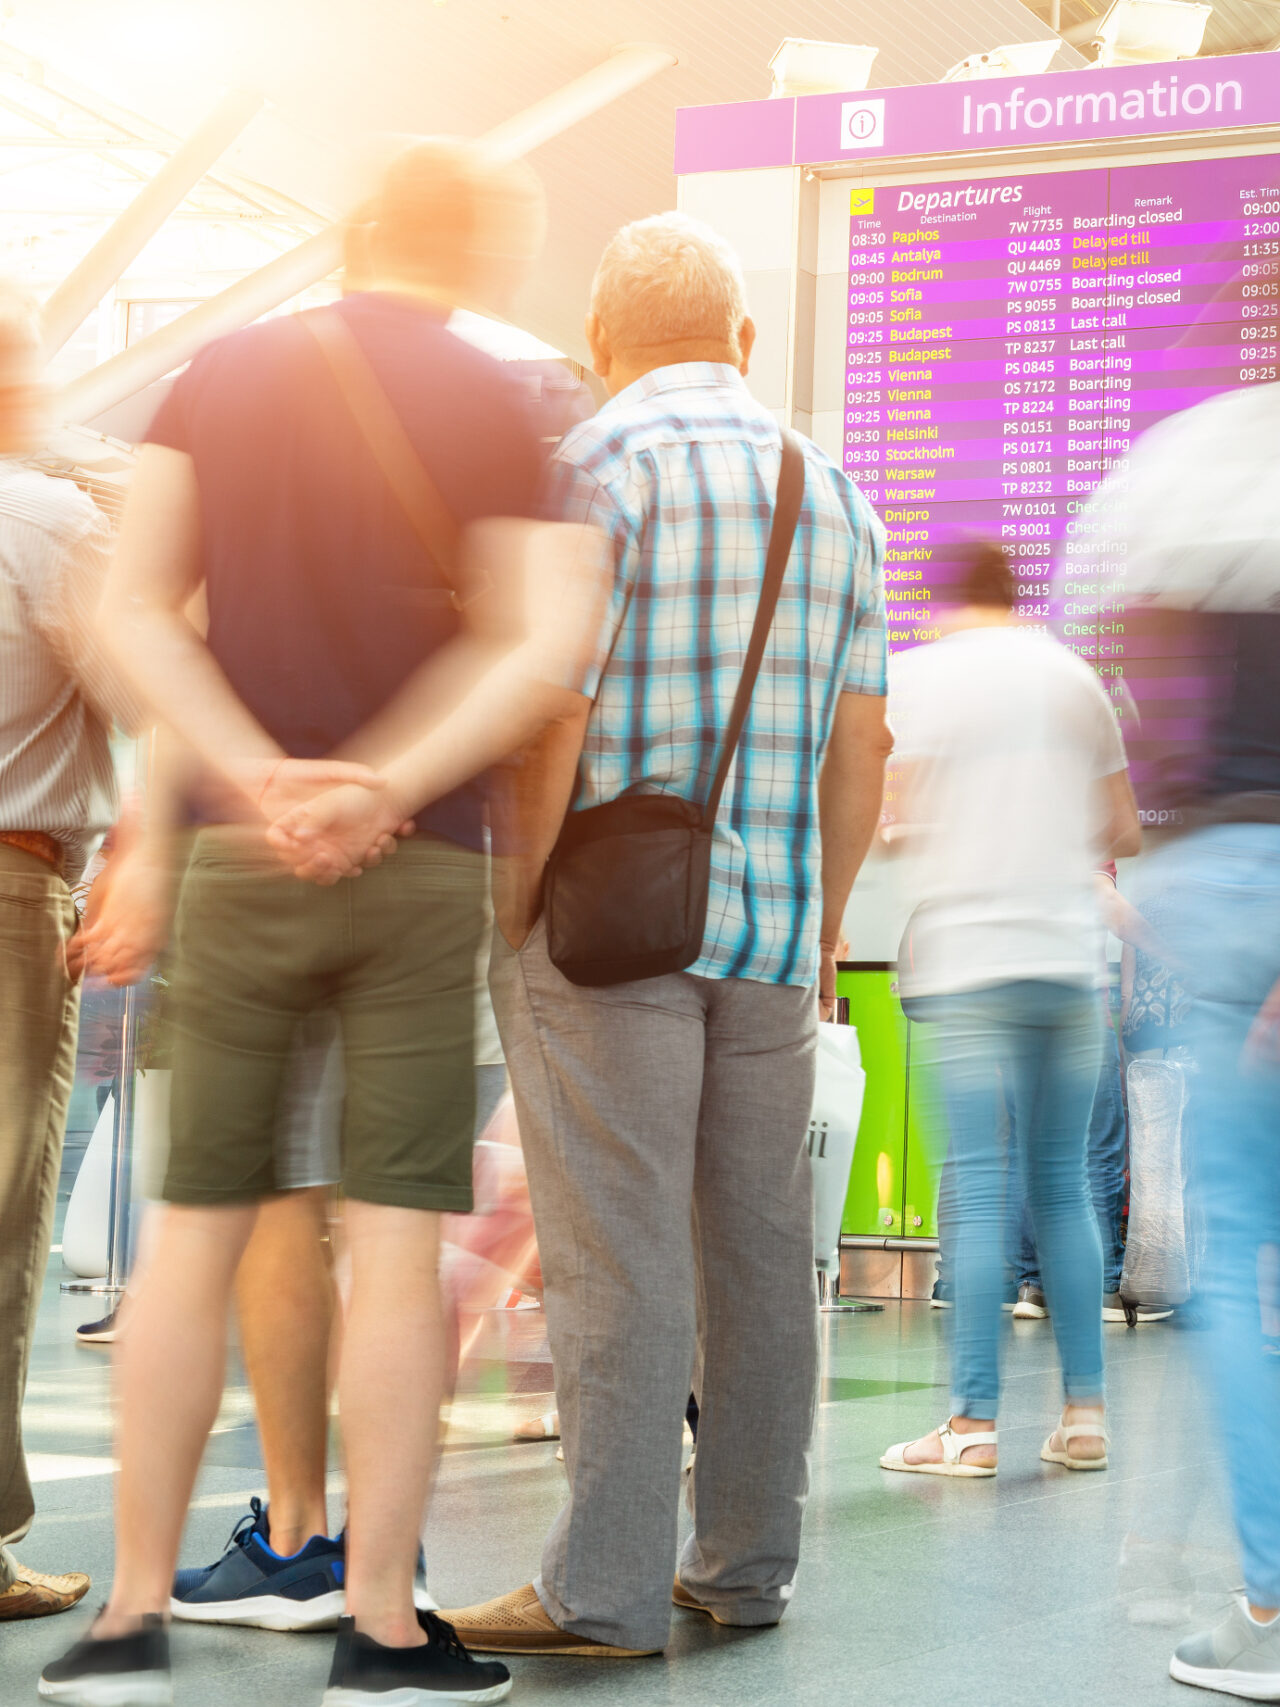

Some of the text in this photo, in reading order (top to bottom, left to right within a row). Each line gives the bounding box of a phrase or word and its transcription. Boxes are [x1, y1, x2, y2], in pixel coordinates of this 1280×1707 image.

[960, 78, 1245, 136] Information
[897, 184, 1023, 214] Departures
[1134, 195, 1173, 208] Remark
[1239, 189, 1257, 199] Est.
[1023, 205, 1052, 218] Flight
[1243, 200, 1280, 216] 09:00
[858, 219, 881, 230] Time
[920, 211, 977, 225] Destination
[1073, 207, 1183, 230] Boarding closed
[1008, 218, 1063, 235] 7W 7735
[1243, 221, 1280, 237] 12:00
[851, 232, 886, 247] 08:30
[892, 228, 940, 246] Paphos
[1072, 231, 1151, 251] Delayed till
[1007, 238, 1062, 256] QU 4403
[1243, 241, 1280, 257] 11:35
[851, 251, 886, 267] 08:45
[890, 247, 942, 264] Antalya
[1072, 251, 1150, 271] Delayed till
[1007, 258, 1062, 276] QU 4469
[850, 271, 885, 286] 09:00
[891, 268, 944, 283] Bodrum
[1071, 268, 1182, 290] Boarding closed
[1007, 277, 1062, 294] 7W 0755
[850, 291, 885, 306] 09:05
[890, 287, 923, 303] Sofia
[1071, 288, 1181, 310] Boarding closed
[1007, 298, 1057, 314] PS 9055
[849, 310, 884, 325] 09:05
[889, 307, 922, 322] Sofia
[1070, 312, 1127, 330] Last call
[889, 325, 953, 343] Budapest
[1006, 318, 1056, 334] PS 0813
[849, 330, 884, 345] 09:25
[1069, 334, 1126, 351] Last call
[1004, 339, 1056, 355] TP 8237
[848, 351, 882, 365] 09:25
[888, 347, 952, 364] Budapest
[1069, 355, 1132, 372] Boarding
[1004, 359, 1055, 375] PS 0845
[847, 370, 882, 385] 09:25
[887, 368, 933, 383] Vienna
[1069, 375, 1132, 392] Boarding
[887, 388, 932, 402] Vienna
[1003, 379, 1056, 395] OS 7172
[847, 390, 881, 405] 09:25
[886, 428, 939, 442] Helsinki
[885, 447, 955, 461] Stockholm
[884, 467, 936, 481] Warsaw
[884, 509, 930, 526] Dnipro
